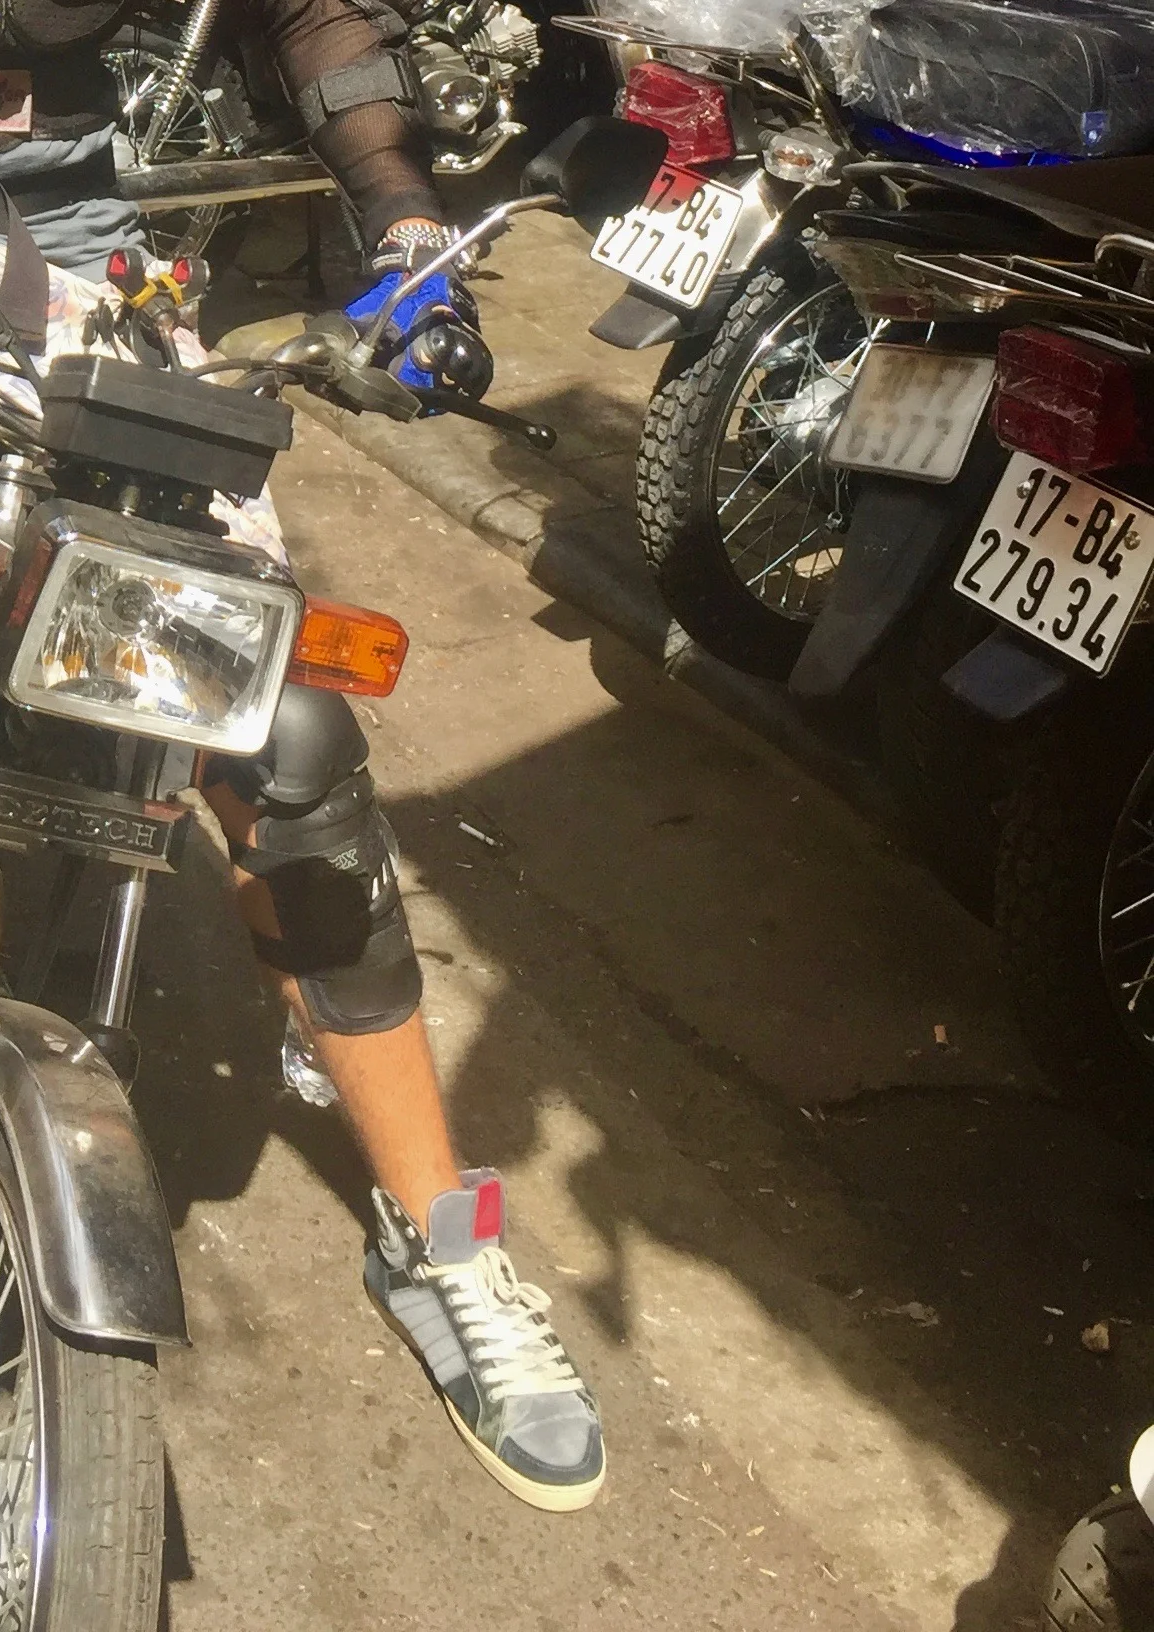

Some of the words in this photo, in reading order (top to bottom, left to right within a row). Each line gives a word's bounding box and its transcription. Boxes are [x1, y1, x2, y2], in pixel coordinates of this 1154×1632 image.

[636, 171, 720, 240] 7-B4
[598, 215, 709, 296] 277.40
[1014, 467, 1137, 580] 17-B4
[961, 528, 1119, 661] 279.34
